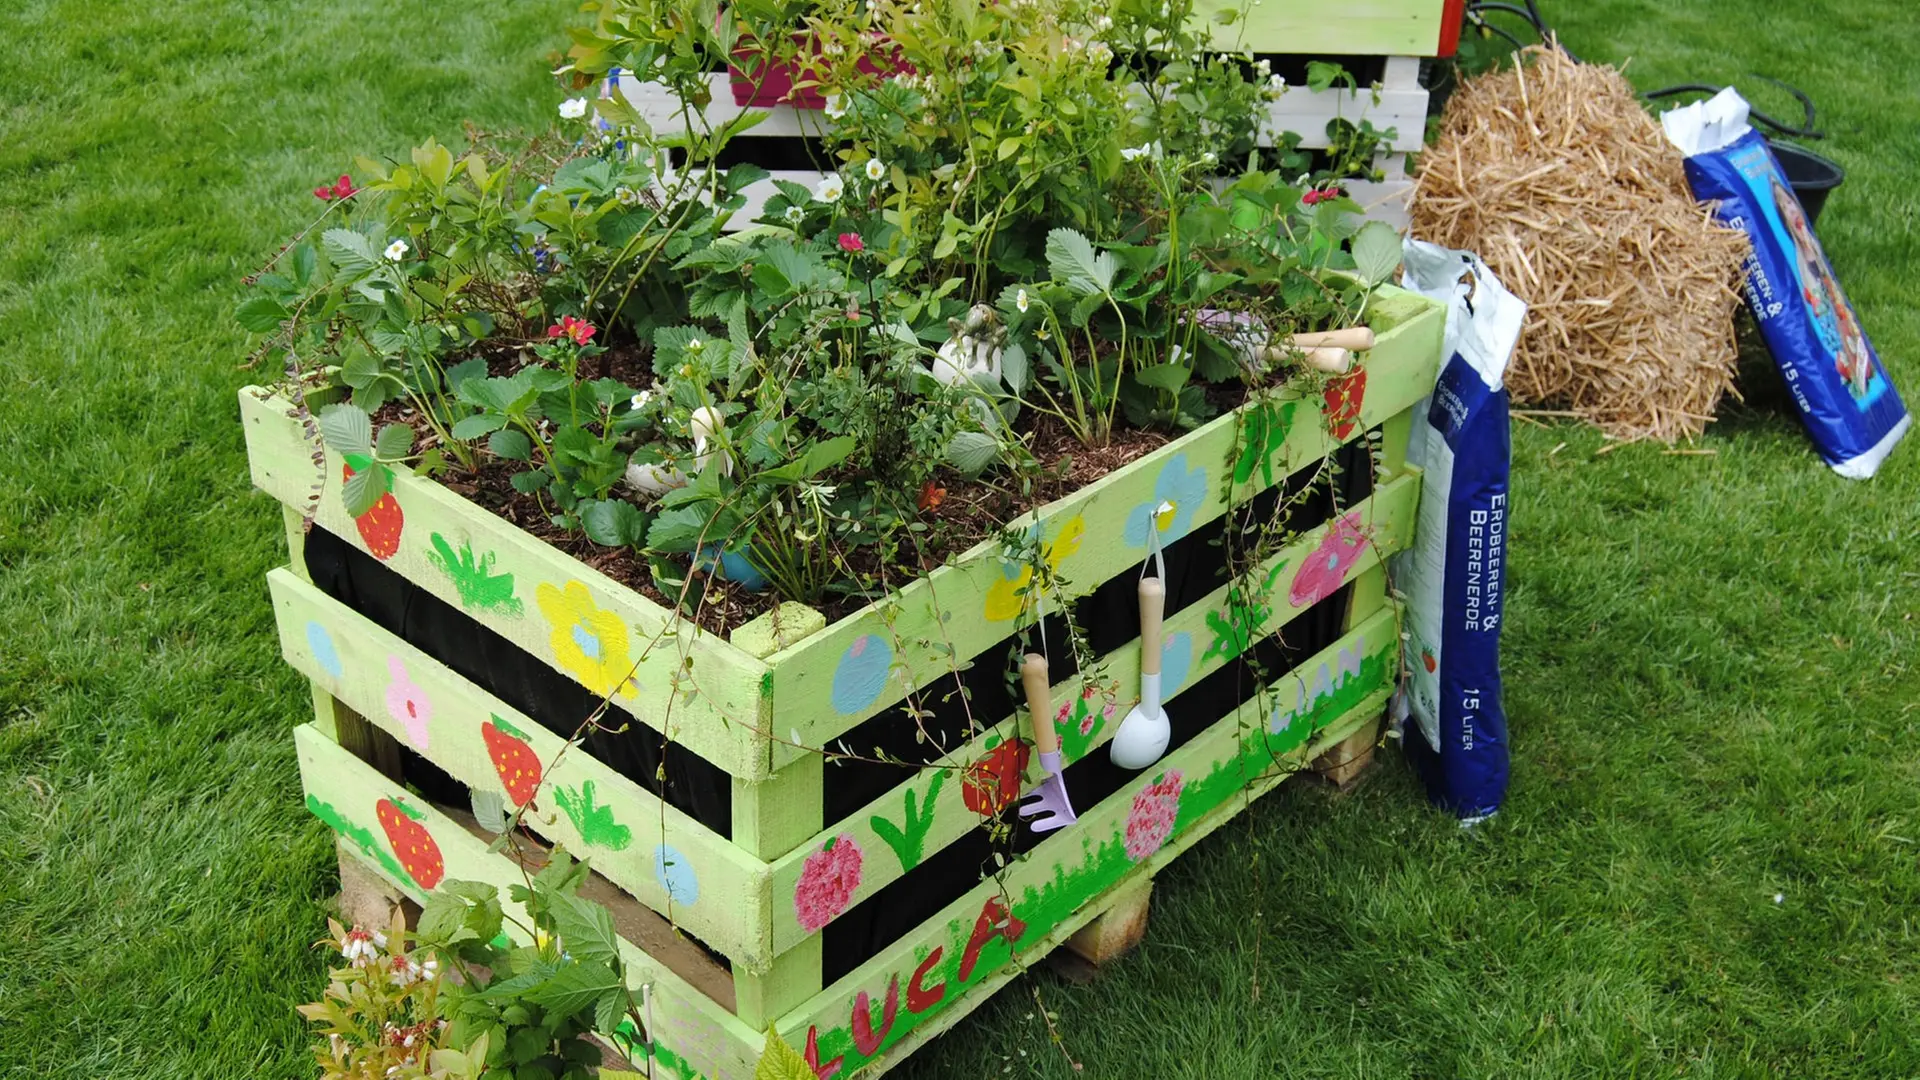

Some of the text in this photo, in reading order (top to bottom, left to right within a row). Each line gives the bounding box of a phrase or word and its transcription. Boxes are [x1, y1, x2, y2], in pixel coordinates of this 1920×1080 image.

[1766, 301, 1783, 318] &
[1781, 361, 1811, 413] 15 LITER
[1465, 510, 1488, 631] BEERENERDE
[1483, 493, 1506, 632] ERDBEEREN- &
[1270, 635, 1365, 735] LIAN
[1463, 689, 1480, 750] 15 LITER
[804, 895, 1028, 1080] LUCA
